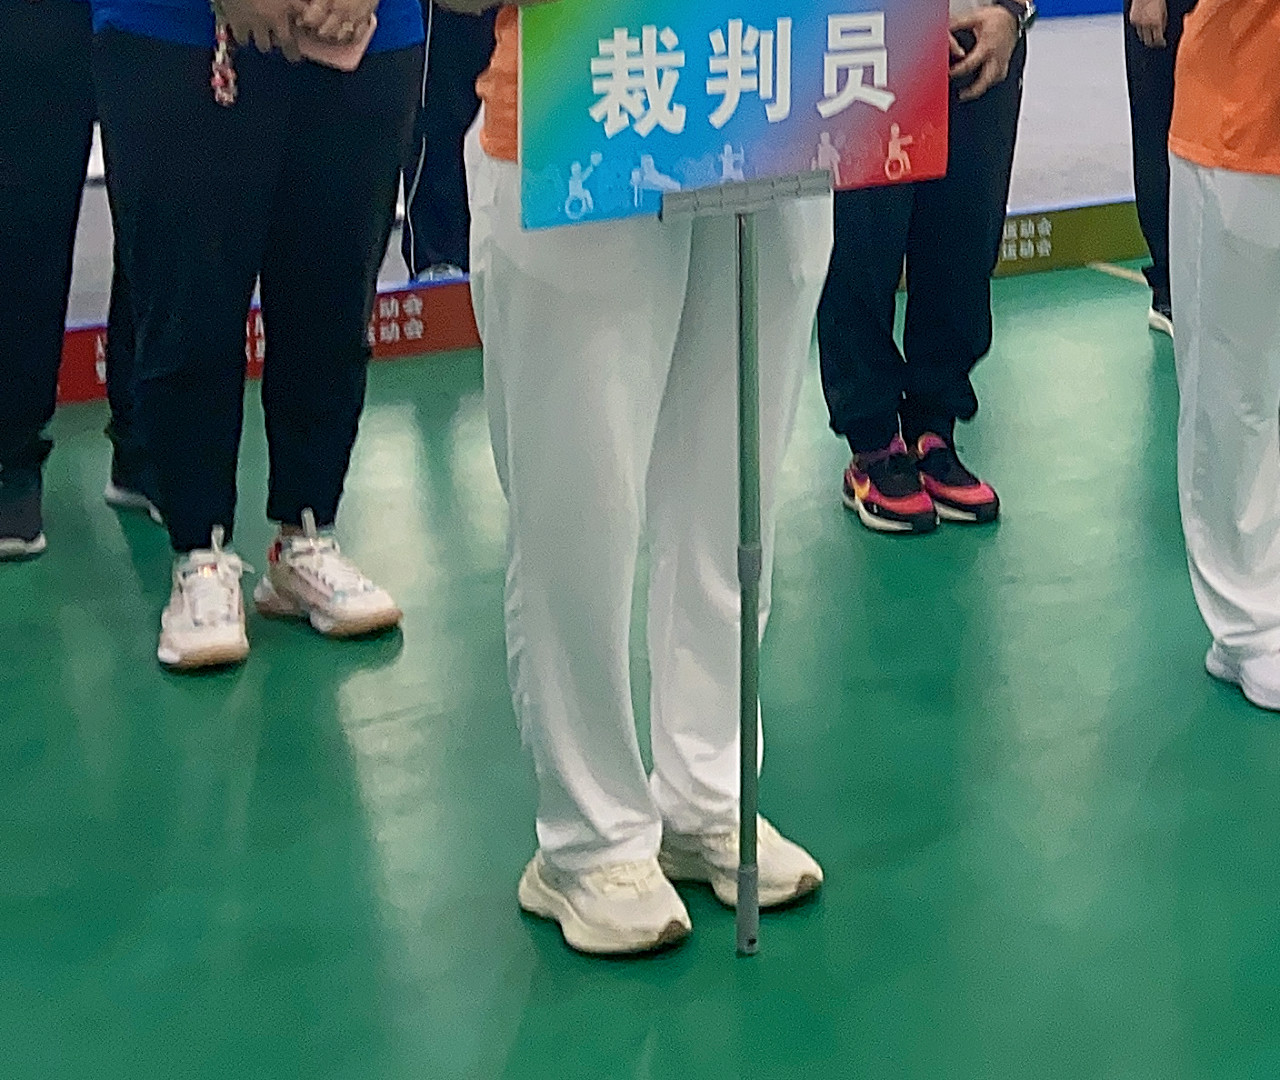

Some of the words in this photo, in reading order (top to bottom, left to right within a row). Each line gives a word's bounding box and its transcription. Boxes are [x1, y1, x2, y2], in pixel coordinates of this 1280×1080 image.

[588, 11, 896, 139] 裁判员
[371, 293, 423, 321] 动会
